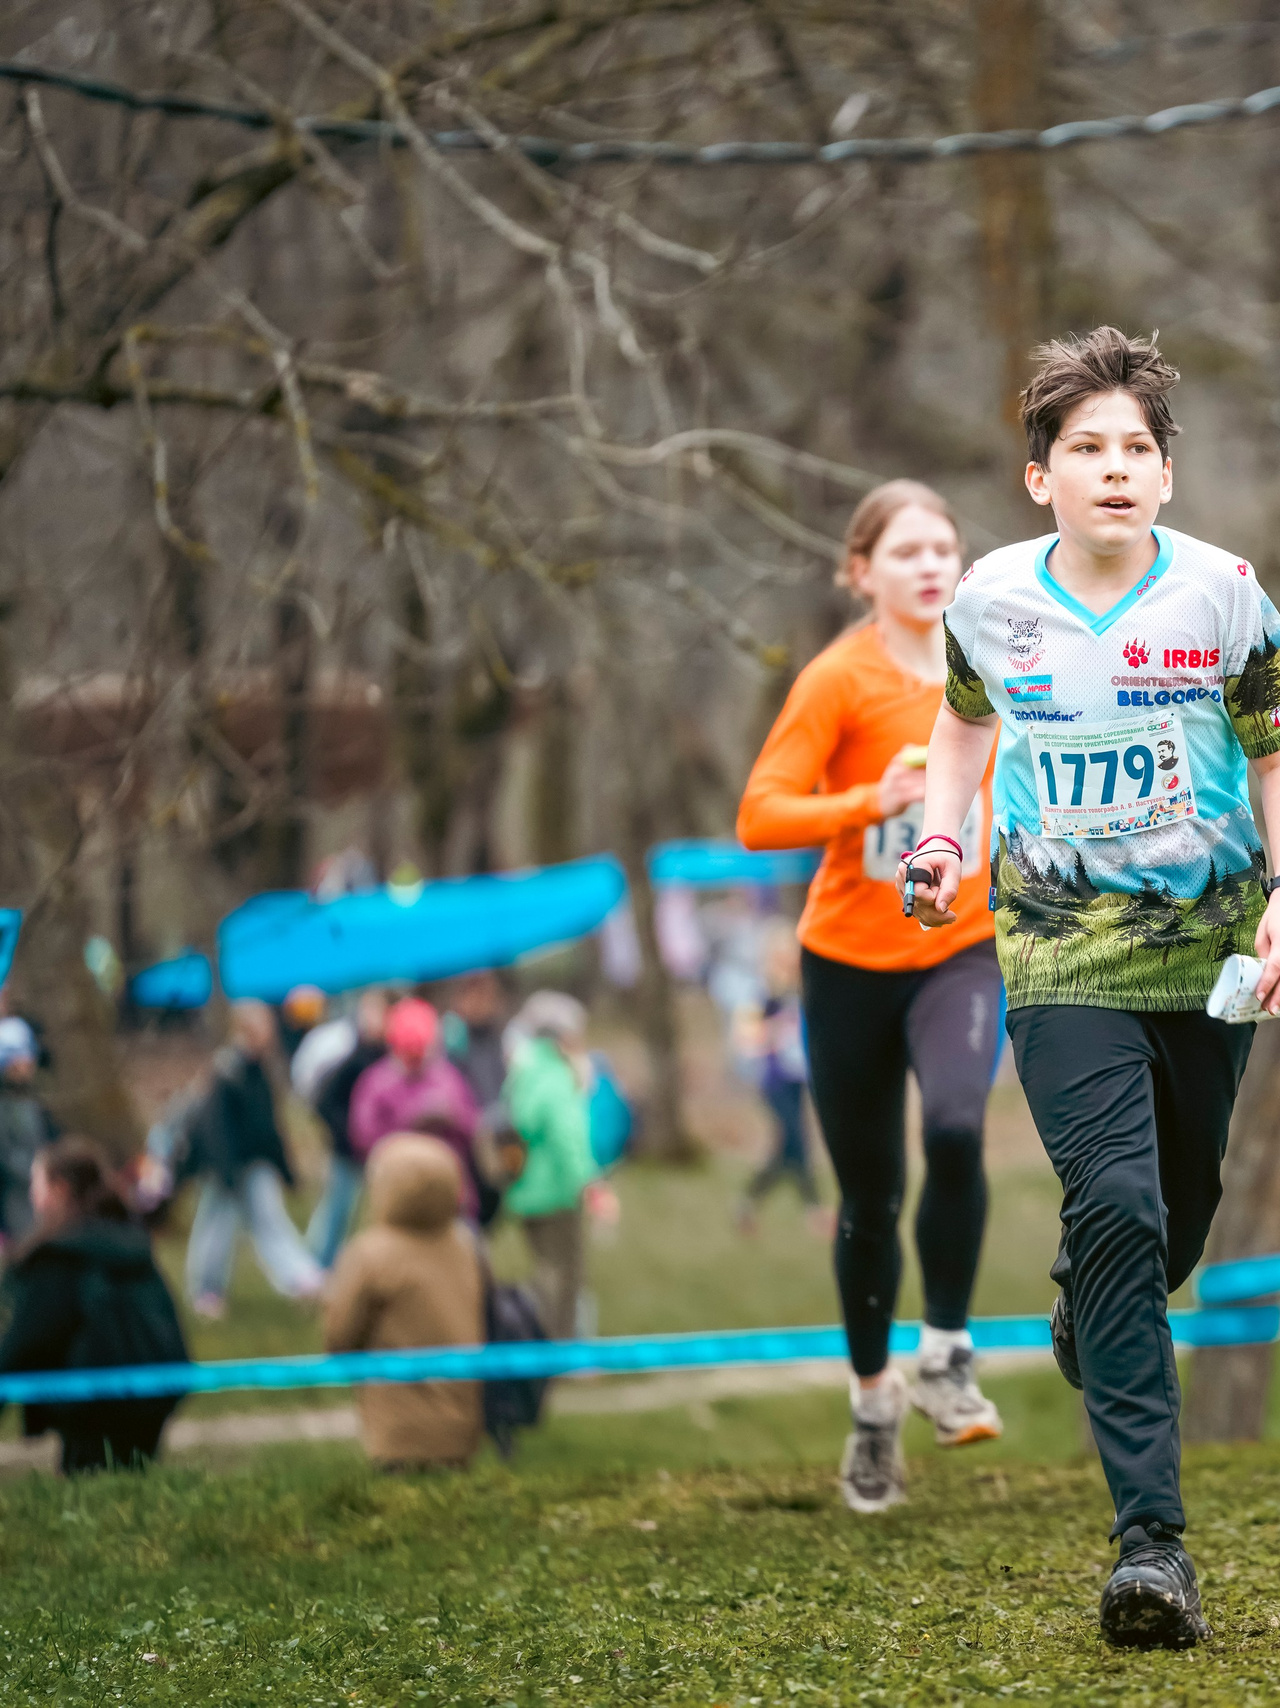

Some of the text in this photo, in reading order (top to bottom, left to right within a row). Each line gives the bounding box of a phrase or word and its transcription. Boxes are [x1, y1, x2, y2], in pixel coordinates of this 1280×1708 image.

[1163, 648, 1220, 668] IRBIS
[1110, 675, 1203, 687] ORIENTEERING
[1117, 687, 1221, 706] BELGOROD
[1039, 744, 1155, 806] 1779
